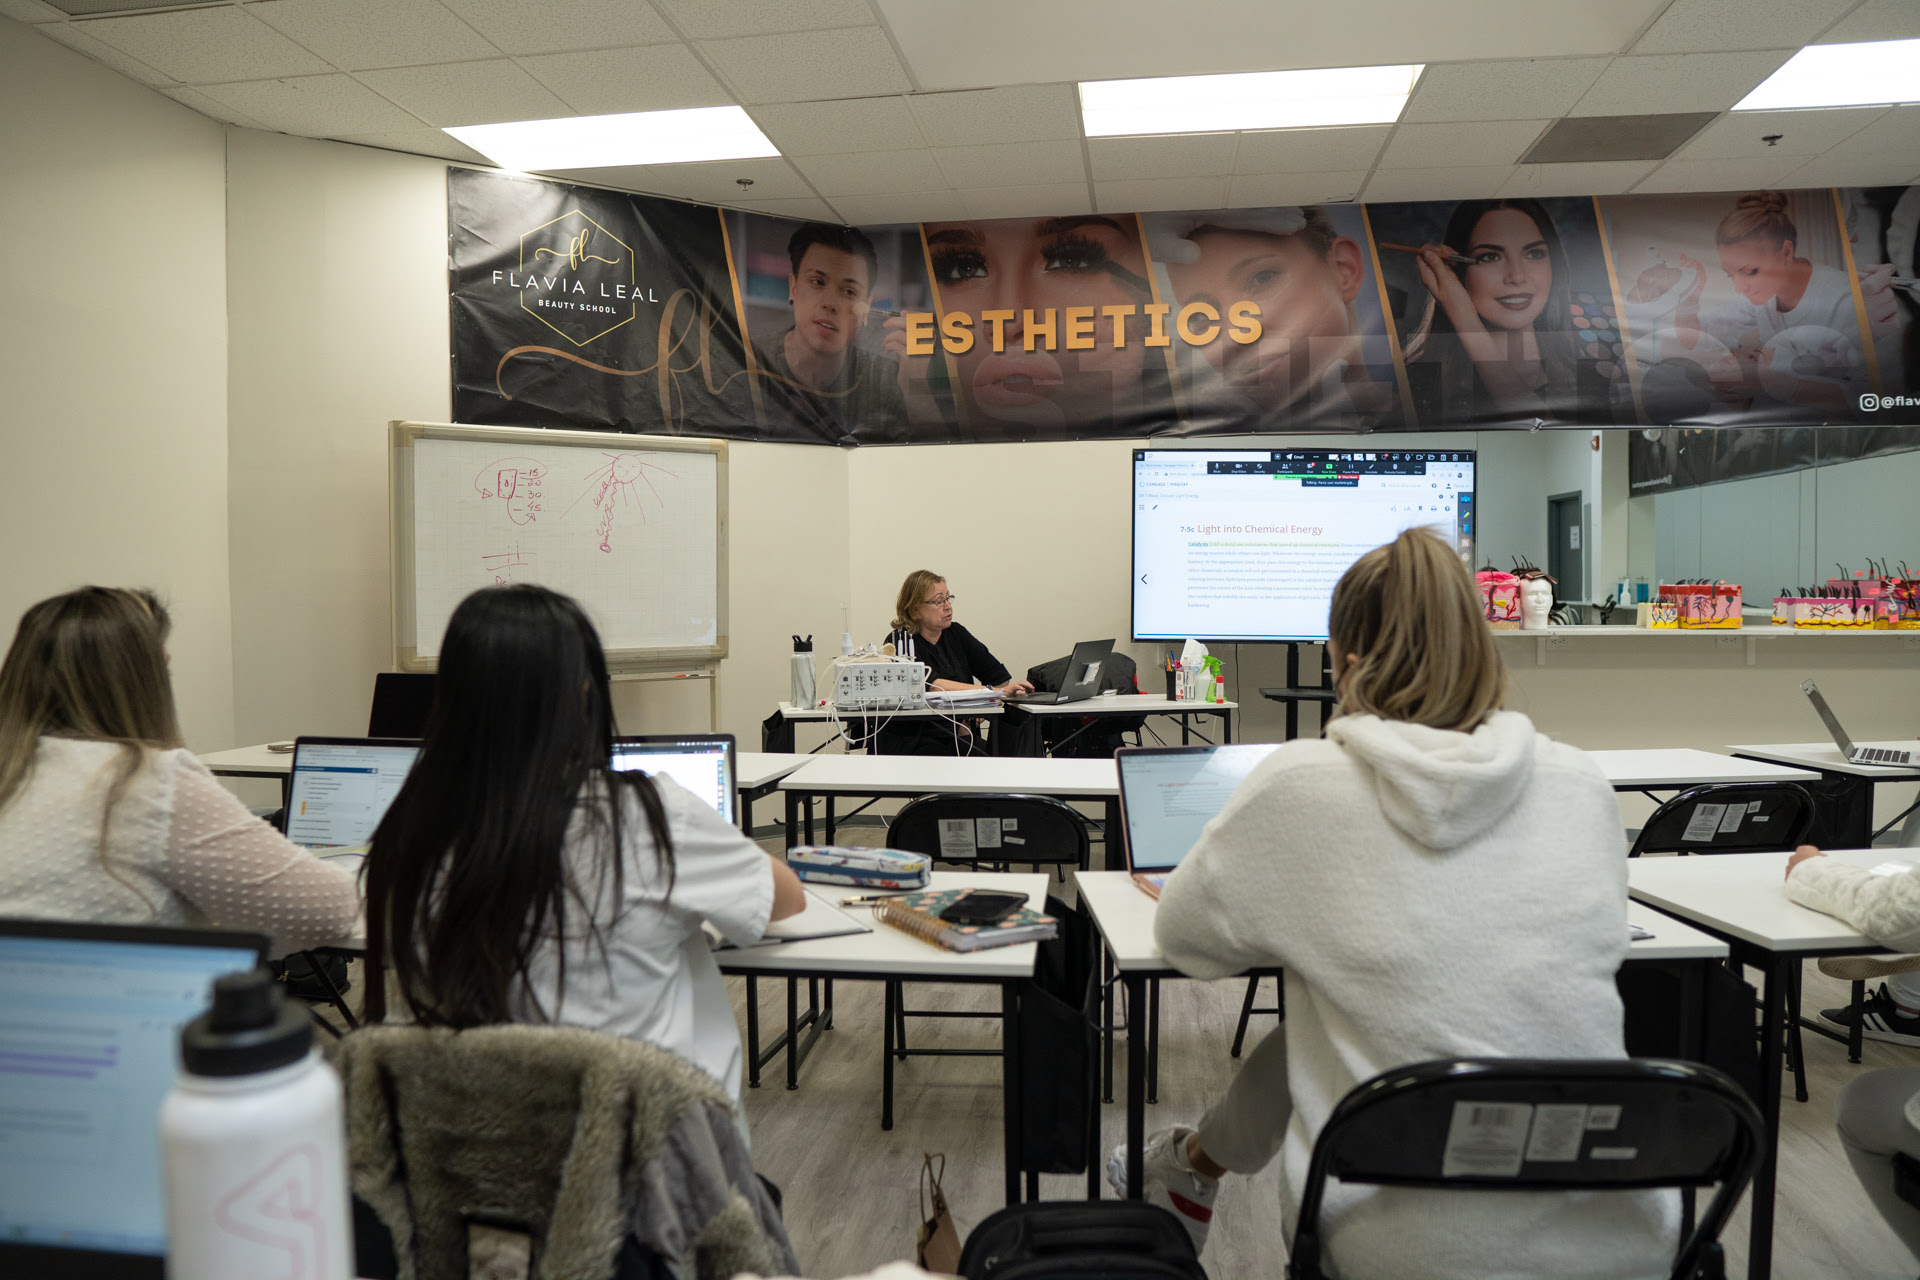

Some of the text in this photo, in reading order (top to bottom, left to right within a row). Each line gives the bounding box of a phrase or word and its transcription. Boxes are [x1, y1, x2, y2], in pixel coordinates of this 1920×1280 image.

[493, 270, 659, 303] FLAVIA LEAL
[538, 299, 617, 314] BEAUTY SCHOOL
[906, 300, 1264, 356] ESTHETICS
[528, 490, 542, 499] 30
[1197, 525, 1221, 535] Light
[1223, 525, 1242, 533] into
[1244, 525, 1288, 533] Chemical
[1291, 525, 1323, 536] Energy
